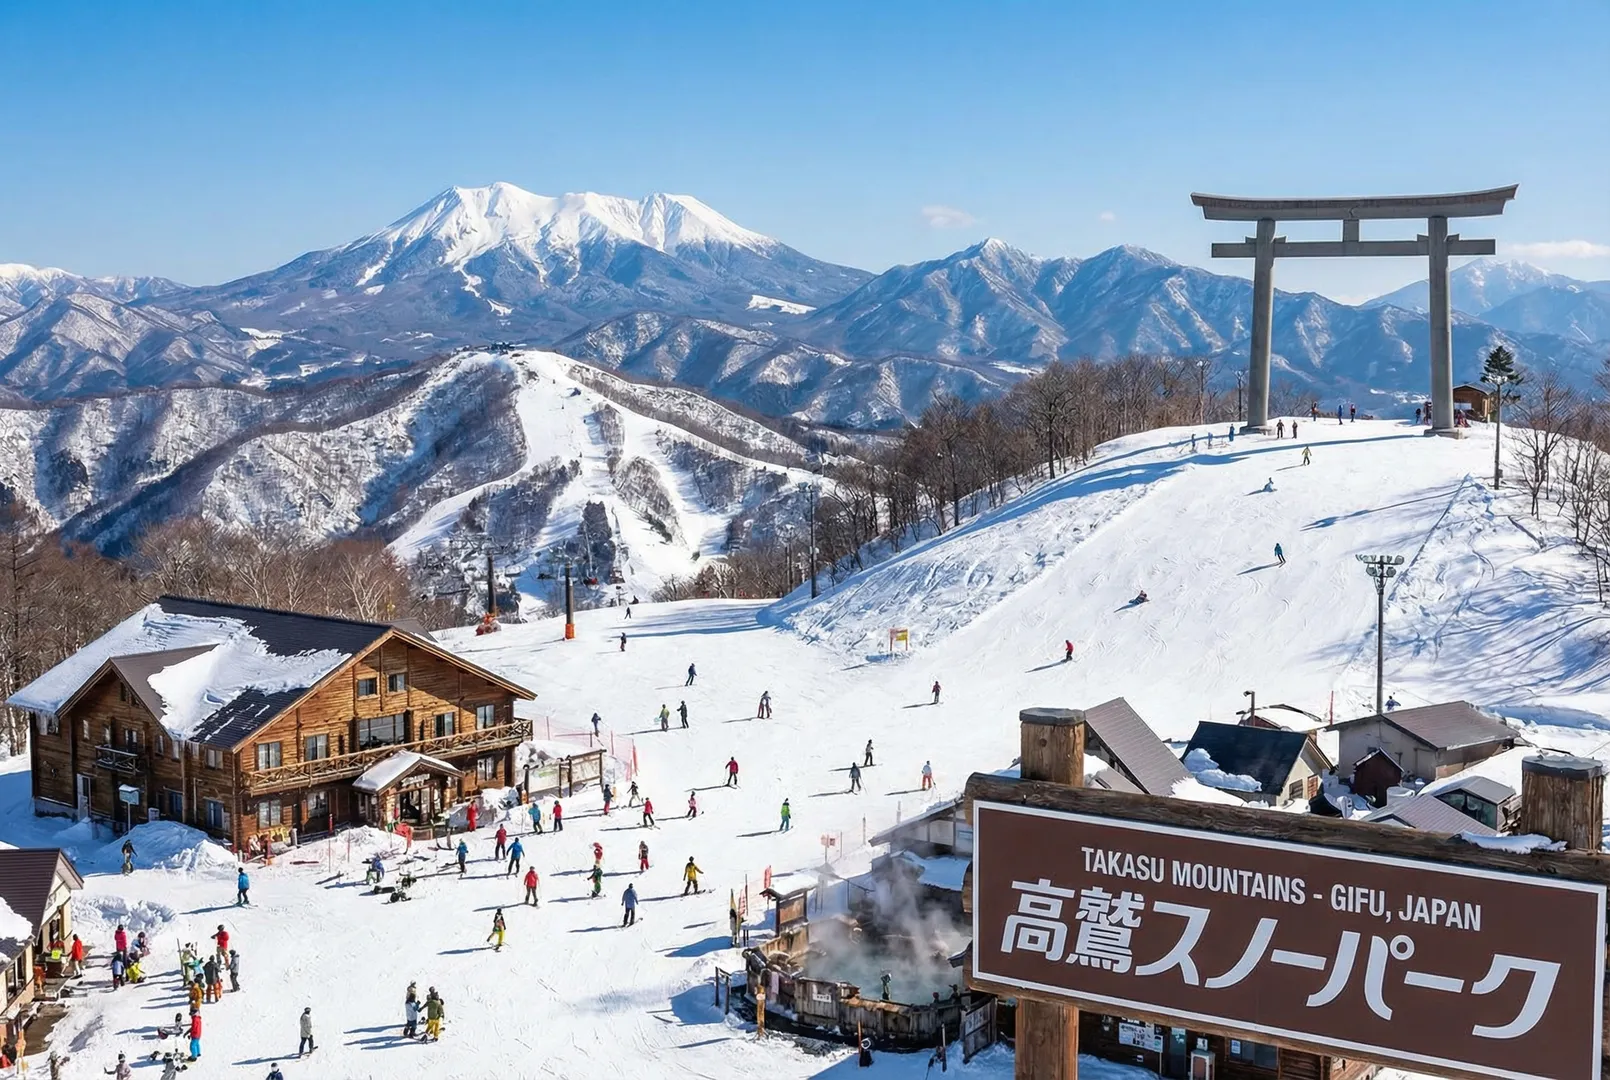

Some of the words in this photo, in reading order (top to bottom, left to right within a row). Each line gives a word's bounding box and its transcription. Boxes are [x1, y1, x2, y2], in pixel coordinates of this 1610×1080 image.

[1081, 846, 1165, 883] TAKASU
[1172, 860, 1306, 905] MOUNTAINS
[1330, 883, 1392, 923] GIFU,
[1398, 894, 1481, 932] JAPAN
[1000, 878, 1562, 1039] 高鷲スノーパーク
